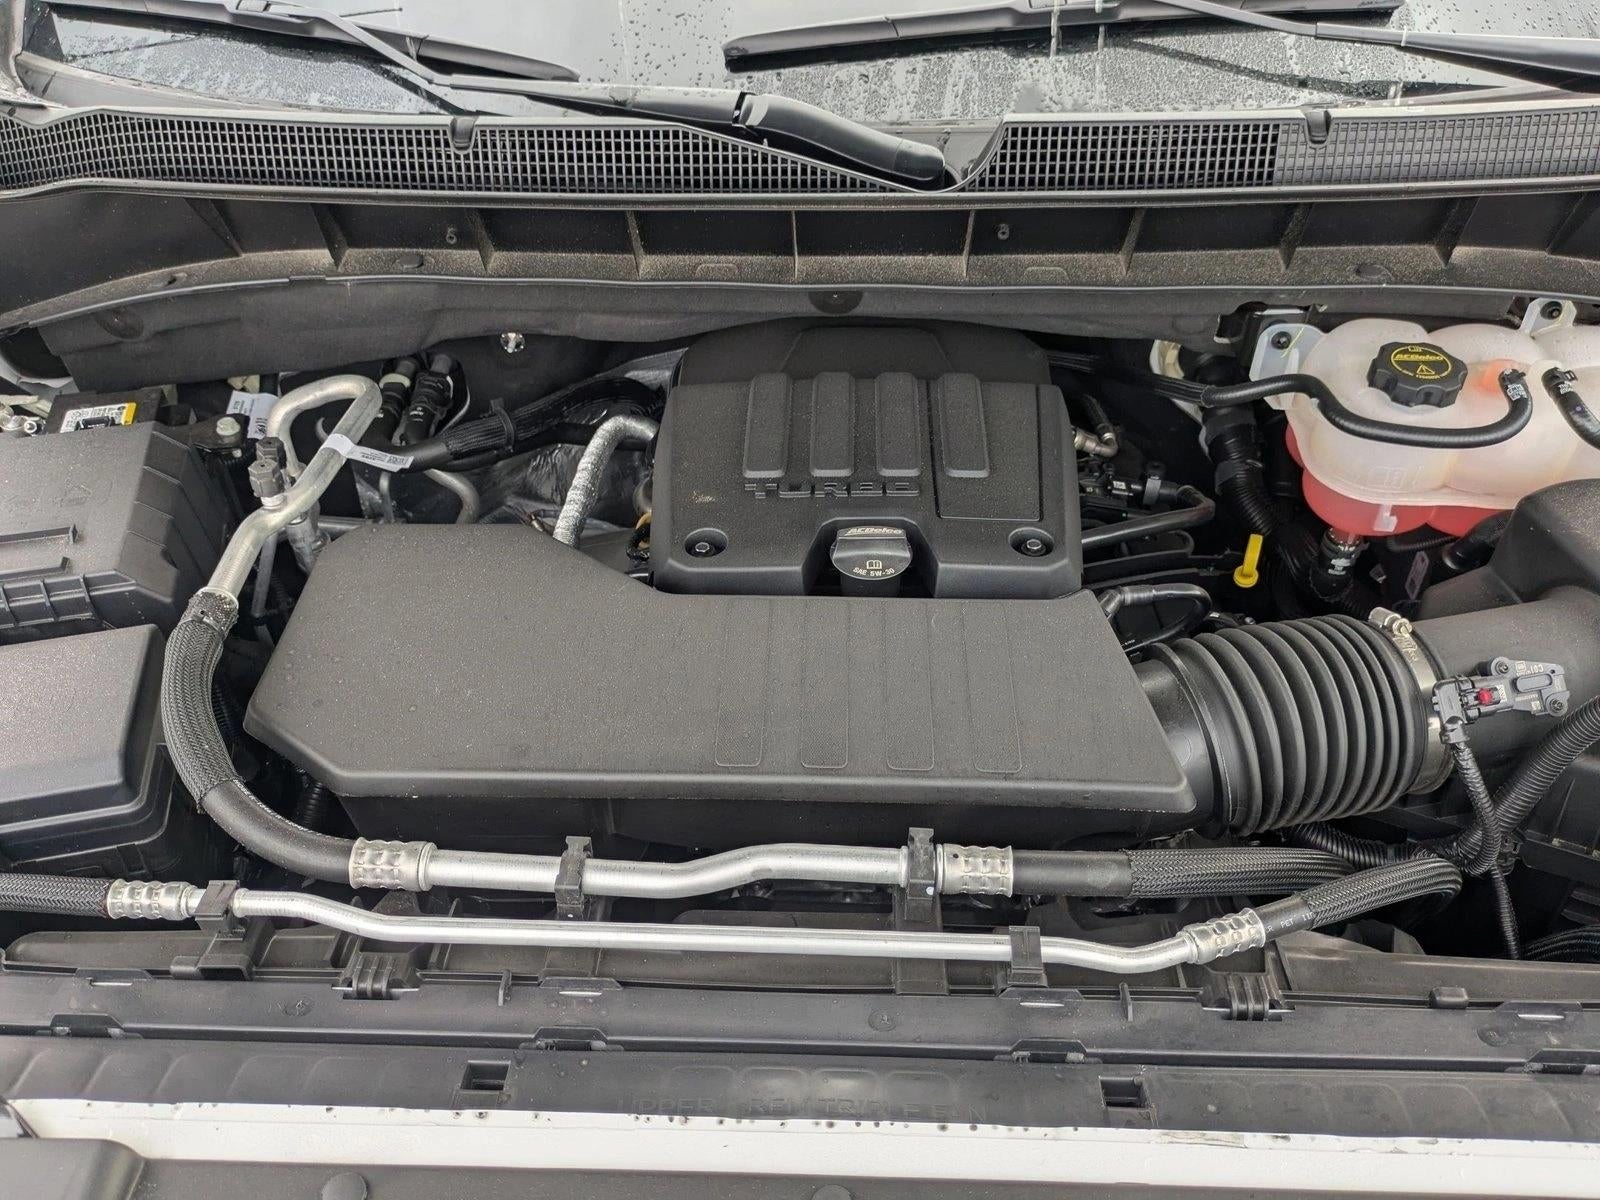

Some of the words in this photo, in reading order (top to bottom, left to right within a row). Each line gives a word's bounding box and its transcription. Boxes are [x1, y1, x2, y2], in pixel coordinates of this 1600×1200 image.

[1394, 353, 1443, 361] ACDelco
[844, 527, 903, 537] ACDelco
[853, 566, 867, 576] SAE
[870, 567, 895, 577] 5W-30
